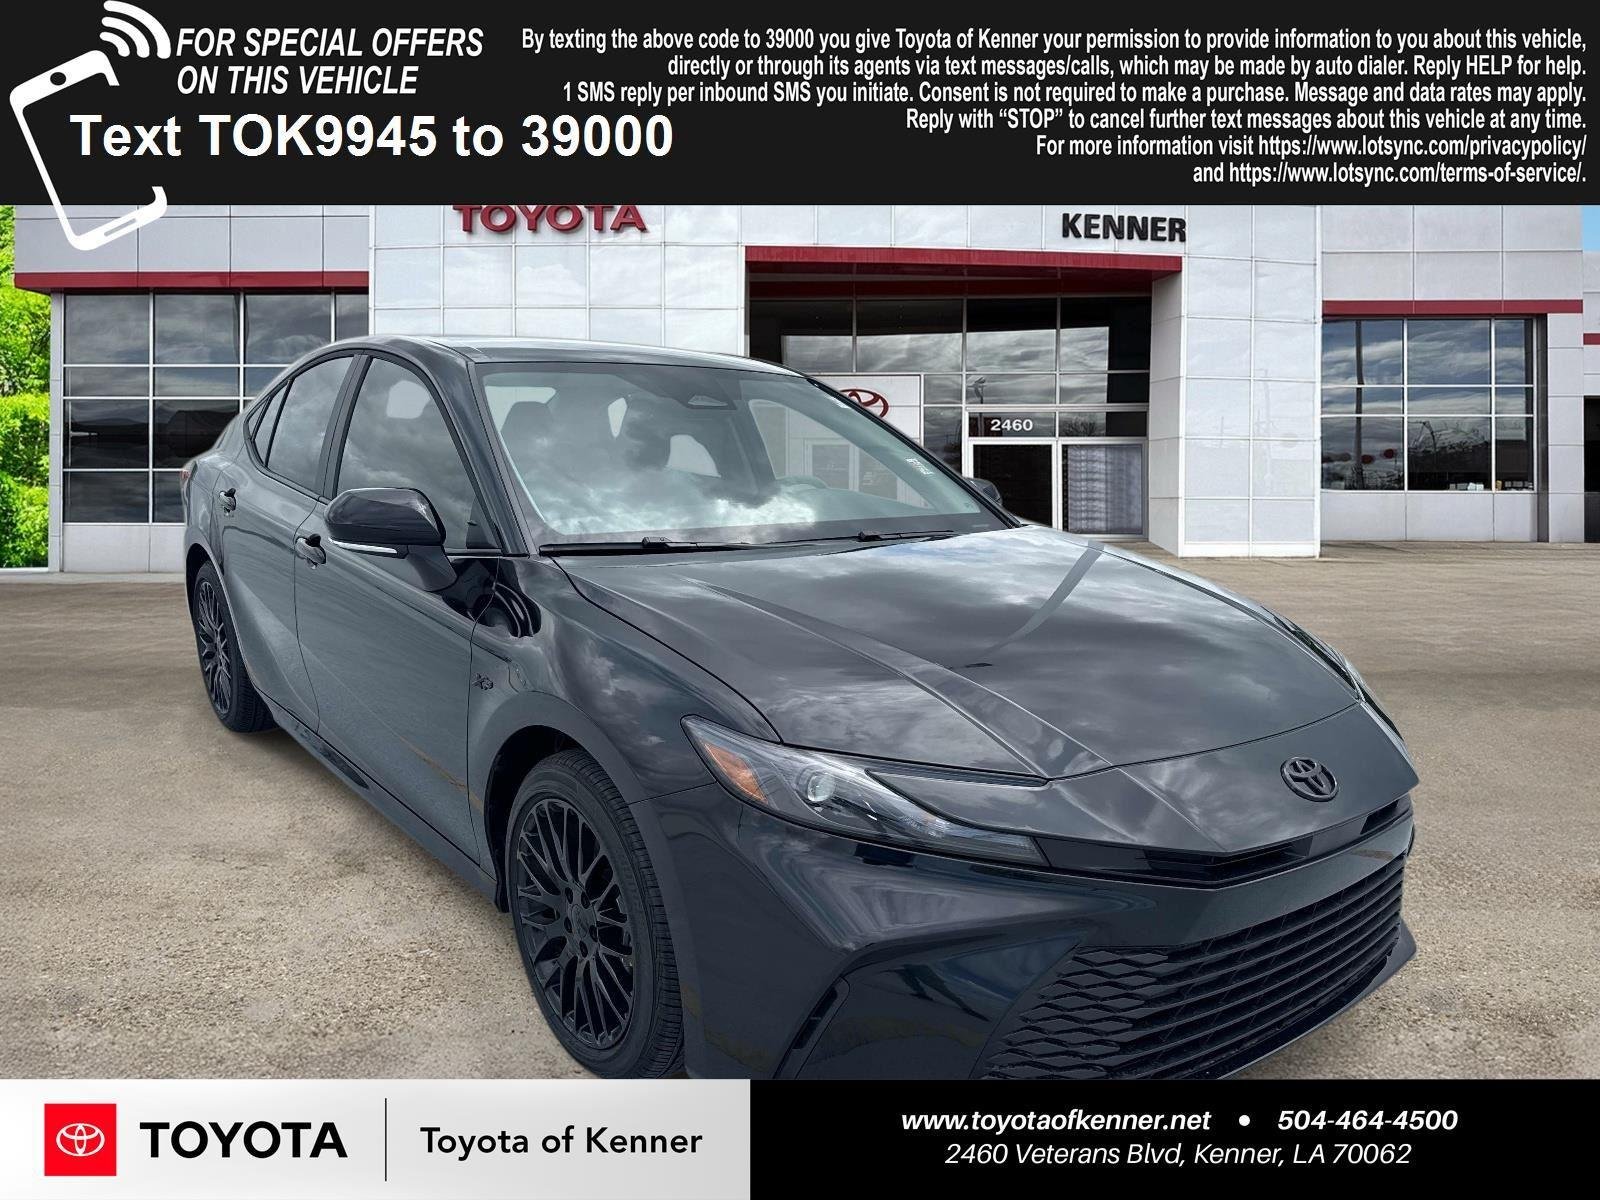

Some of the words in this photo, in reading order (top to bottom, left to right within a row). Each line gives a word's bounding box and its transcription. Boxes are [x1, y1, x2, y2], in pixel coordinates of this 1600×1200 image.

[453, 205, 647, 232] TOYOTA
[1062, 212, 1187, 242] KENNER
[990, 418, 1033, 432] 2460
